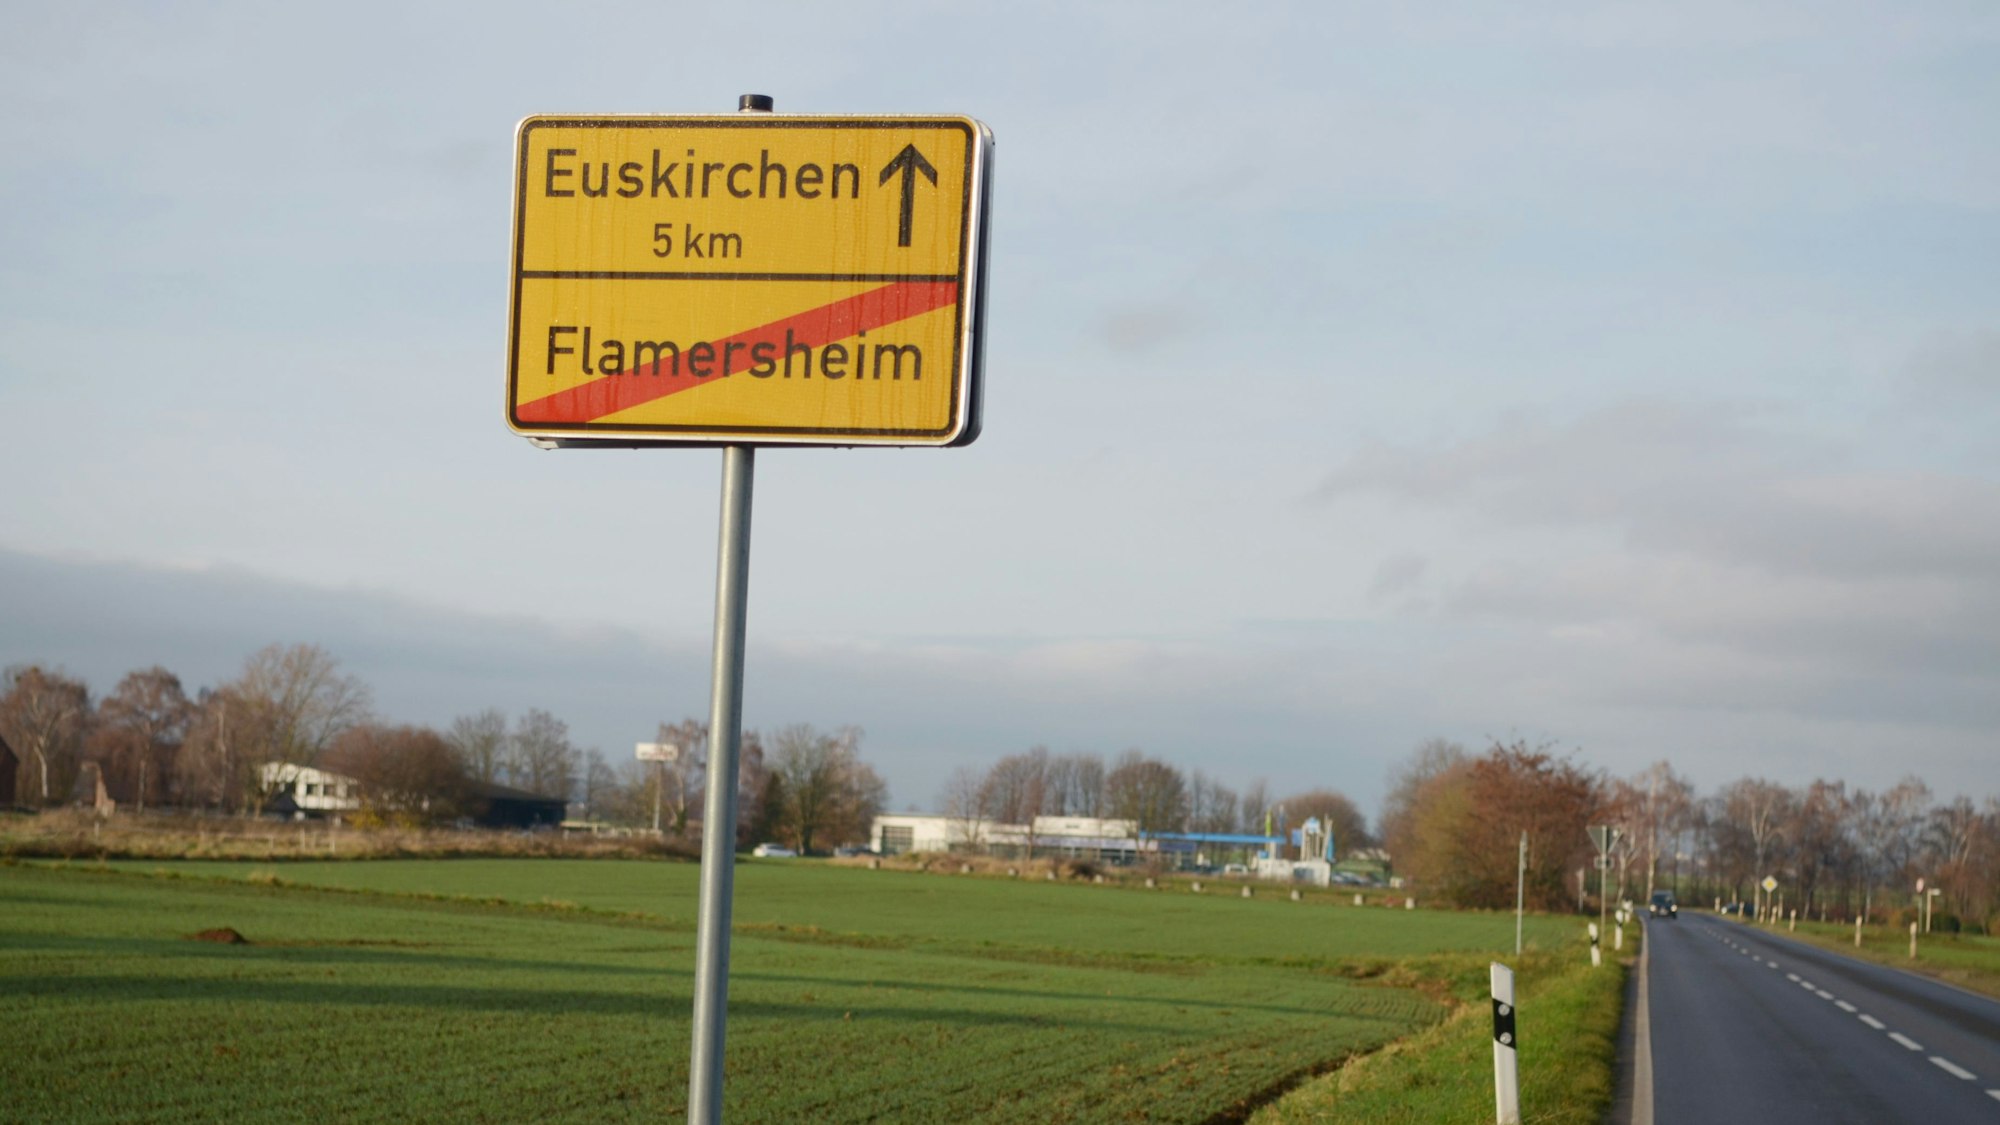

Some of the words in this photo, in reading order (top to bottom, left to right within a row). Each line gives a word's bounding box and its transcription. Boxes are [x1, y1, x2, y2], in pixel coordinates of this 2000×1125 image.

[546, 149, 860, 199] Euskirchen
[653, 223, 672, 258] 5
[684, 223, 742, 258] km
[547, 325, 922, 380] Flamersheim
